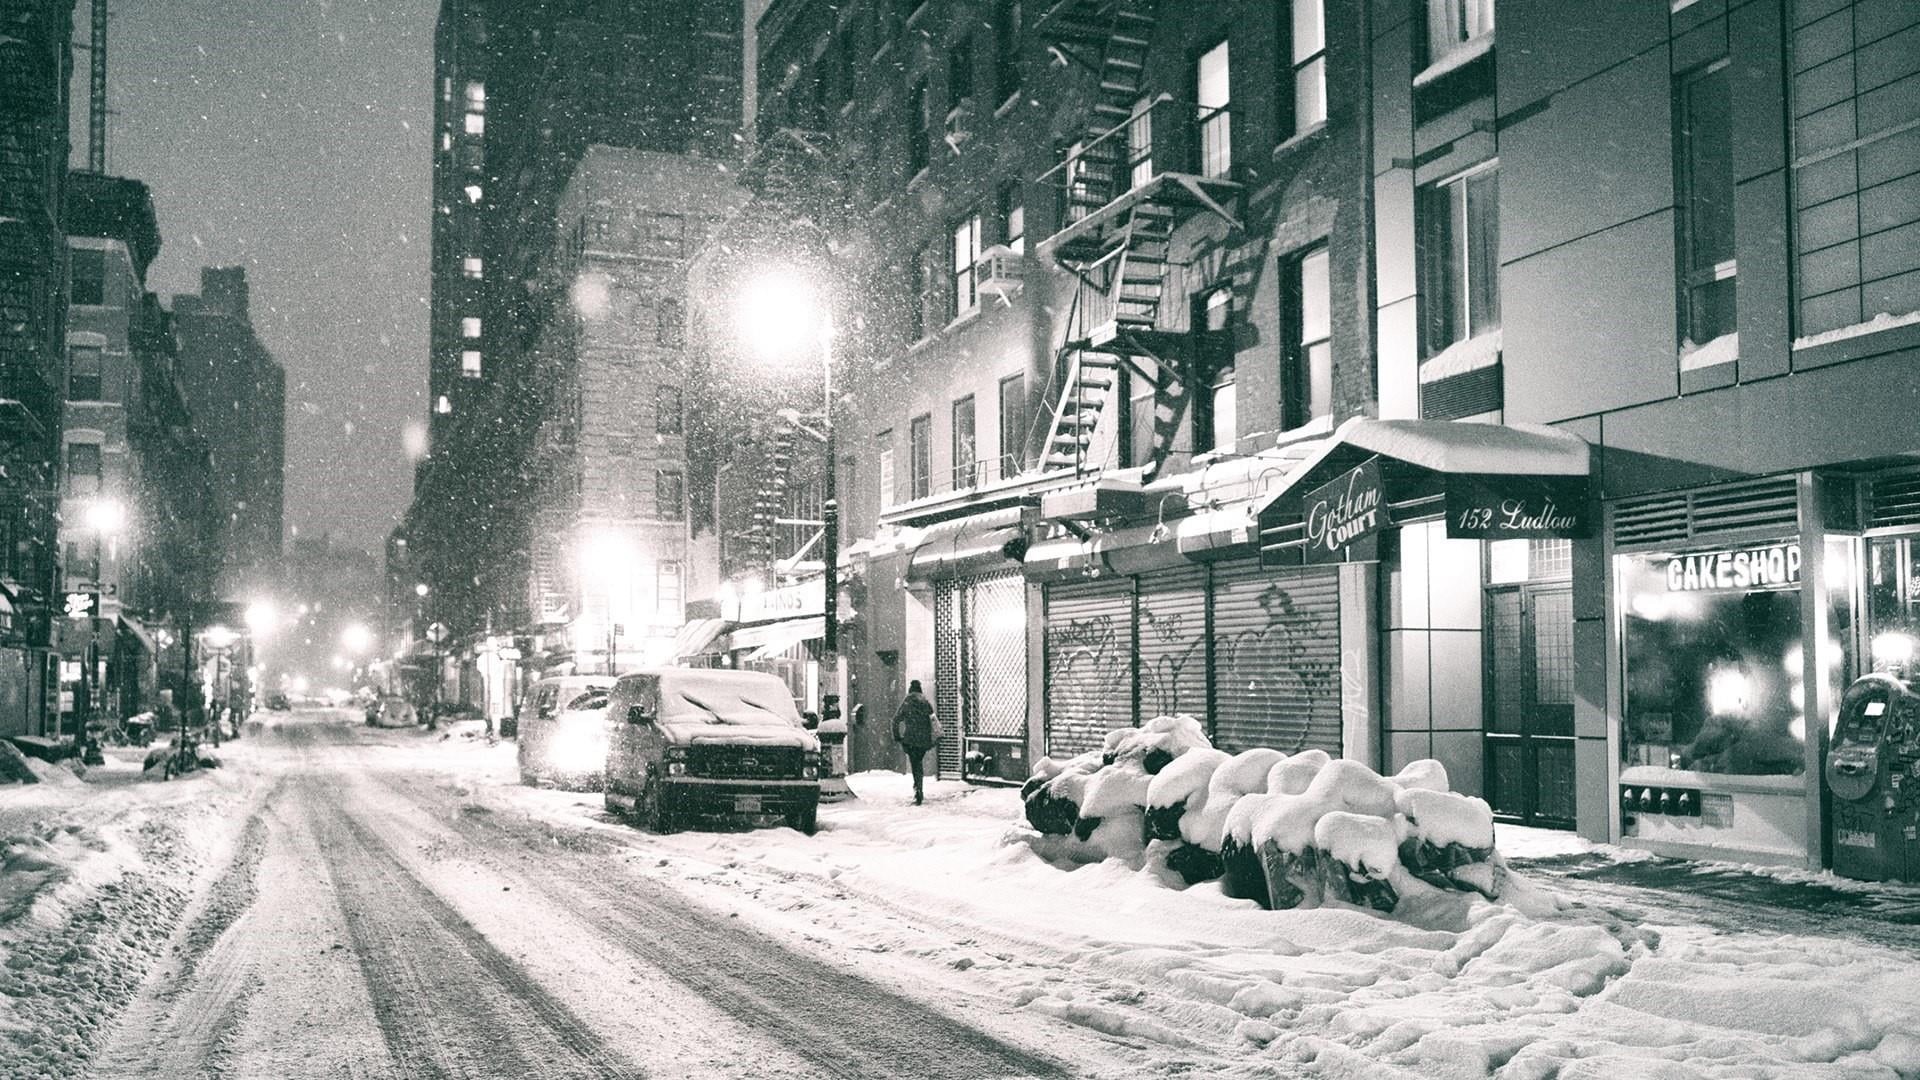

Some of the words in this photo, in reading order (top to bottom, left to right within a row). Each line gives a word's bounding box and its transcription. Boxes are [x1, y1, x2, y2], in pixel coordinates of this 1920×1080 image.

[1309, 467, 1381, 549] Gotham
[1460, 508, 1492, 529] 152
[1499, 499, 1576, 529] Ludlow
